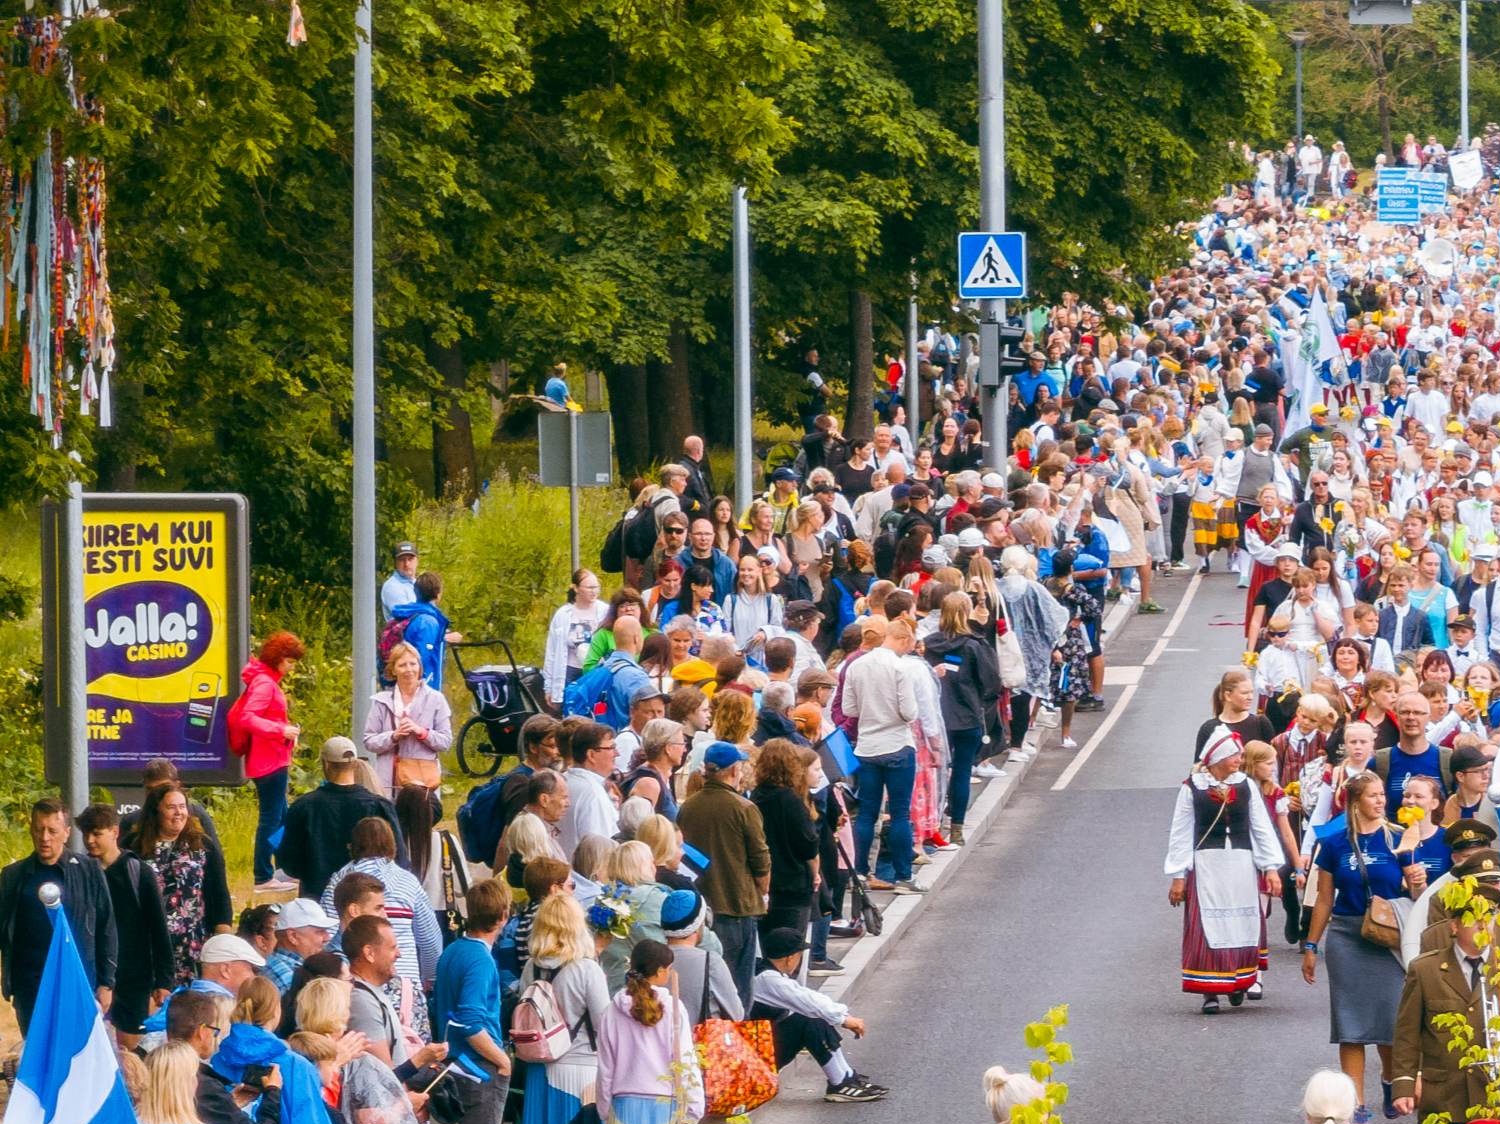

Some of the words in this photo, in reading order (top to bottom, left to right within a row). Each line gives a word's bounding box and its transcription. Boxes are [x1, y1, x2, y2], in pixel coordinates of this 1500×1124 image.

[170, 520, 213, 544] KUI
[82, 548, 142, 575] ESTI
[152, 546, 214, 572] SUVI
[83, 602, 198, 649] Jalla!
[126, 641, 188, 663] CASINO
[111, 708, 133, 725] JA
